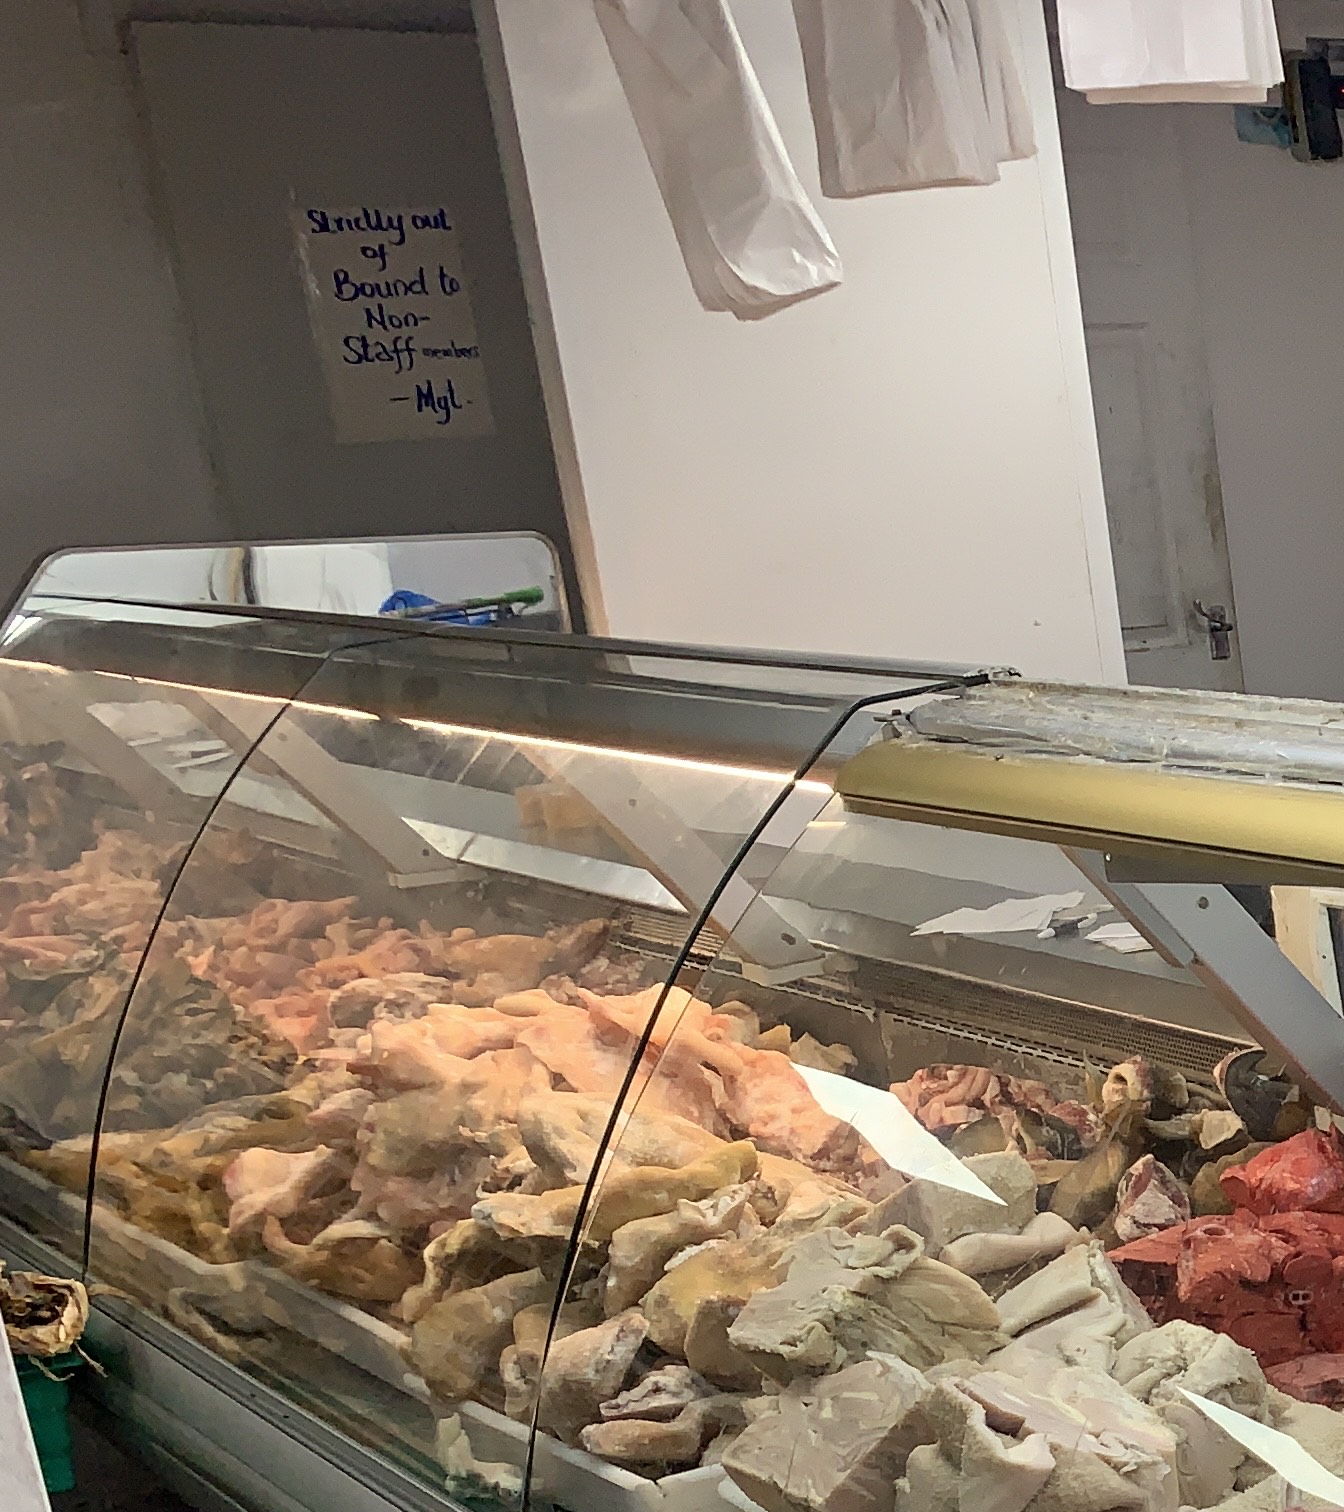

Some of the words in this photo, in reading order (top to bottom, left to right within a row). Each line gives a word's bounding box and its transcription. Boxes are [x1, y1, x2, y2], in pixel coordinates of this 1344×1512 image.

[307, 207, 405, 245] Strictly
[411, 208, 451, 231] out
[360, 243, 389, 272] of
[333, 267, 429, 301] Bound
[438, 264, 460, 296] to
[365, 303, 431, 333] Non-
[342, 335, 416, 374] Staff
